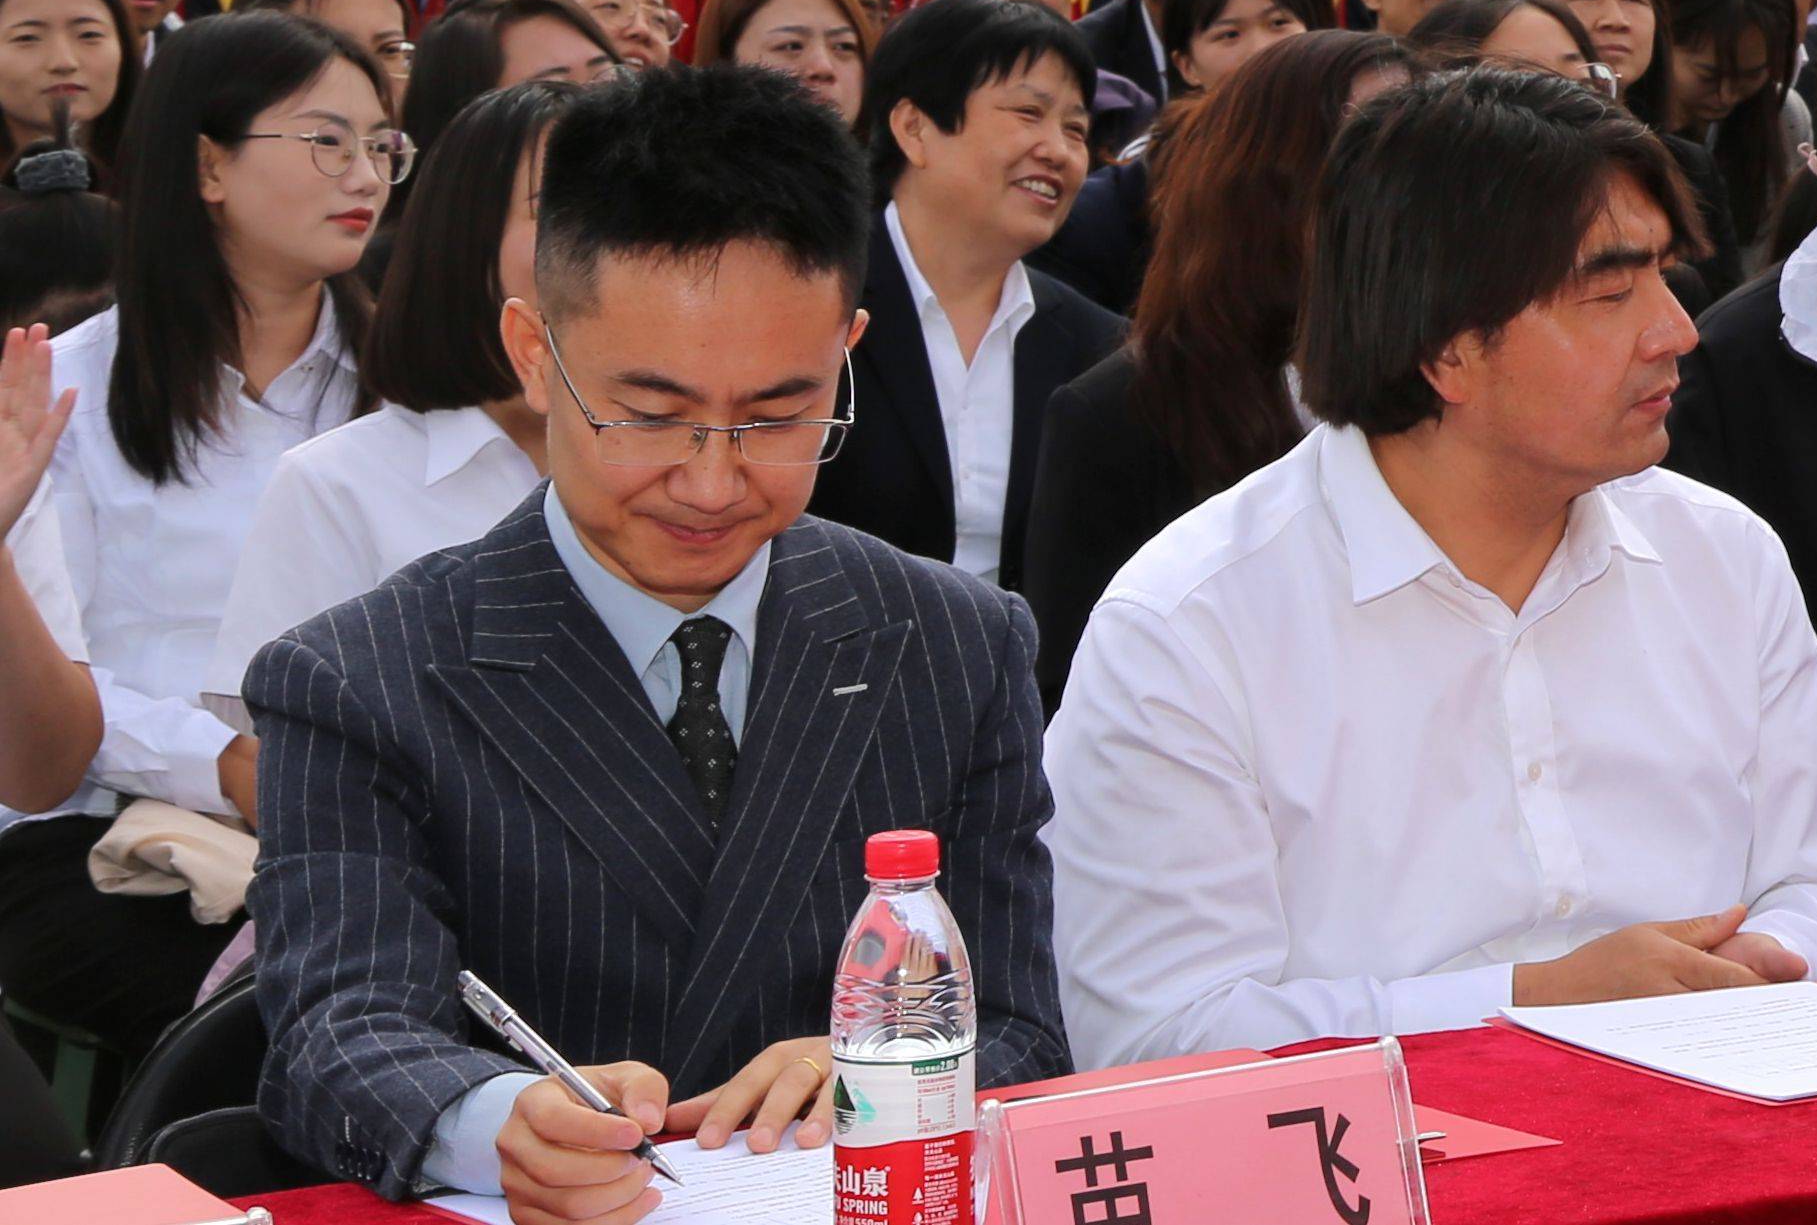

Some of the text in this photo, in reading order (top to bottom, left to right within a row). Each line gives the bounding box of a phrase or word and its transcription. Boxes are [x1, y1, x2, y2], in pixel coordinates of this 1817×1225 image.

[1055, 1130, 1154, 1225] 苗
[1266, 1107, 1371, 1225] 飞
[843, 1197, 888, 1215] SPRING
